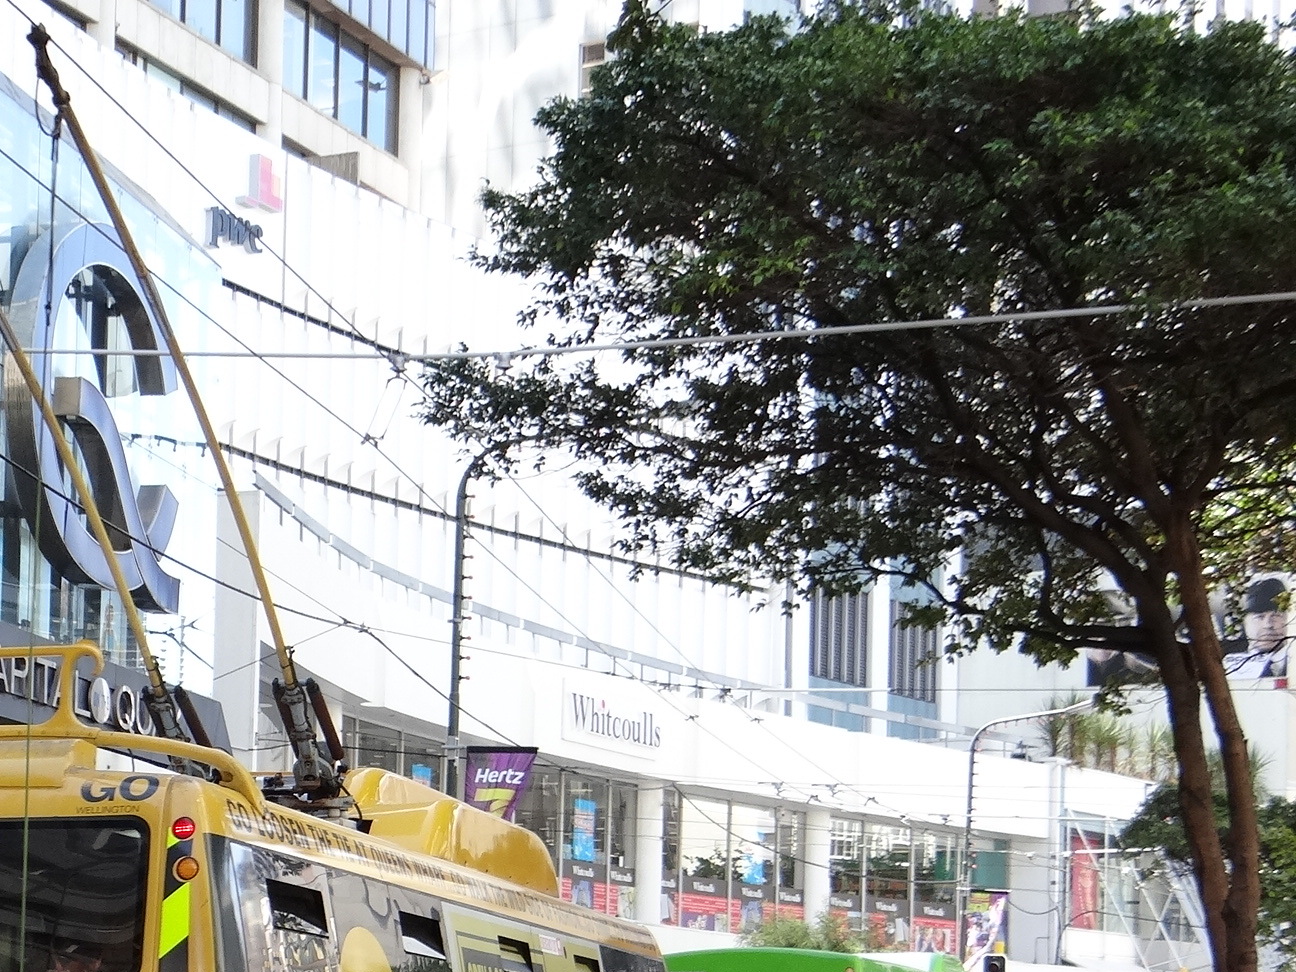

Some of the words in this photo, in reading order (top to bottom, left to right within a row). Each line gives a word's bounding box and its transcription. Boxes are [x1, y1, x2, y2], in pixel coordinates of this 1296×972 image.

[571, 693, 661, 748] Whitcoulls
[475, 768, 525, 785] Hertz
[81, 776, 160, 803] GO
[76, 804, 140, 814] WELLINGTON
